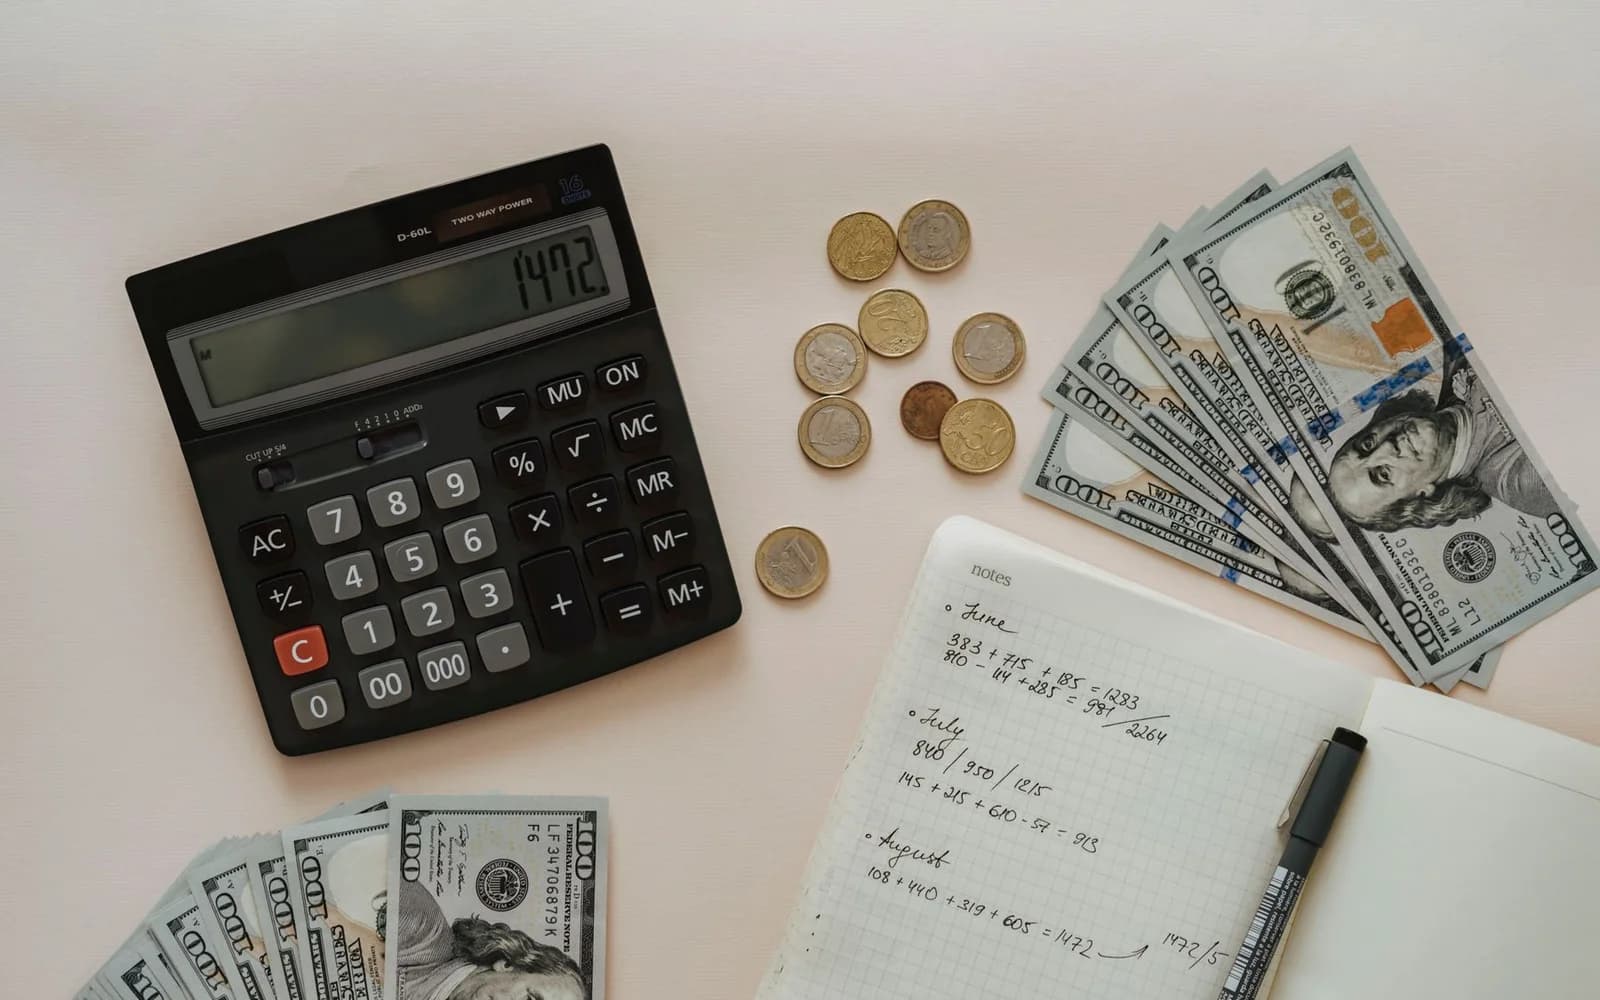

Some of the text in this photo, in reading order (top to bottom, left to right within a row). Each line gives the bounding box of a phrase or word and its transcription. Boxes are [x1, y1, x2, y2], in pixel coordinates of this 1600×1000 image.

[452, 197, 533, 226] TWO WAY POWER
[1328, 183, 1389, 265] 100
[397, 226, 432, 243] D-60L
[1311, 210, 1377, 310] ML 83801932 C
[1195, 263, 1241, 325] 100
[1131, 301, 1181, 358] 100
[1229, 332, 1271, 393] DOLLARS
[1246, 317, 1295, 387] STATES
[1266, 323, 1323, 407] AMERICA
[606, 362, 639, 385] ON
[1092, 358, 1150, 410] 100
[1187, 347, 1244, 413] STATES
[547, 379, 582, 404] MU
[1172, 362, 1223, 423] DOLLARS
[1072, 384, 1129, 432] 100
[620, 414, 657, 440] MC
[1144, 413, 1204, 468] DOLLARS
[245, 443, 286, 462] CUT UP 5/4
[509, 452, 534, 476] %
[446, 473, 465, 497] 9
[637, 471, 674, 497] MR
[1306, 456, 1327, 485] ONE
[388, 491, 407, 515] 8
[1052, 472, 1116, 512] 100
[326, 508, 342, 534] 7
[1123, 488, 1198, 528] STATES
[252, 529, 286, 557] AC
[463, 528, 482, 552] 6
[1117, 510, 1187, 547] DOLLARS
[1543, 509, 1589, 569] 100
[405, 546, 423, 572] 5
[1377, 532, 1397, 559] NOTE
[345, 565, 363, 588] 4
[970, 564, 1012, 587] notes
[1393, 557, 1424, 601] RESERVE
[1400, 547, 1450, 617] 83801932
[480, 583, 498, 607] 3
[551, 594, 572, 615] +
[667, 581, 703, 606] M+
[422, 602, 442, 627] 2
[619, 604, 641, 619] =
[961, 603, 1020, 634] June
[1419, 599, 1449, 643] FEDERAL
[1443, 616, 1462, 636] ML
[1456, 597, 1481, 626] L12
[363, 621, 376, 643] 1
[1397, 597, 1444, 658] 100
[291, 639, 313, 663] C
[944, 650, 968, 667] 810
[426, 654, 465, 683] 000
[946, 633, 981, 655] 383
[1002, 652, 1033, 670] 715
[1057, 672, 1085, 689] 185
[1103, 687, 1139, 710] 1283
[369, 673, 402, 700] 00
[310, 695, 327, 718] 0
[920, 708, 964, 750] July
[1126, 723, 1167, 745] 2264
[912, 740, 944, 760] 840
[964, 761, 994, 780] 950
[1014, 778, 1053, 796] 1215
[899, 771, 925, 788] 145
[944, 787, 971, 805] 215
[989, 805, 1017, 822] 610
[1073, 832, 1098, 853] 913
[527, 824, 539, 842] F6
[878, 828, 951, 868] August
[403, 818, 420, 882] 100
[575, 818, 593, 880] 100
[299, 854, 328, 922] 100
[544, 824, 560, 936] LF 34706879 K
[265, 875, 300, 942] 100
[867, 866, 891, 884] 108
[908, 879, 938, 901] 440
[956, 899, 986, 918] 319
[1002, 915, 1038, 935] 605
[1054, 928, 1093, 959] 1472
[1273, 889, 1287, 910] papel,
[212, 890, 254, 957] 100
[179, 927, 229, 992] 100
